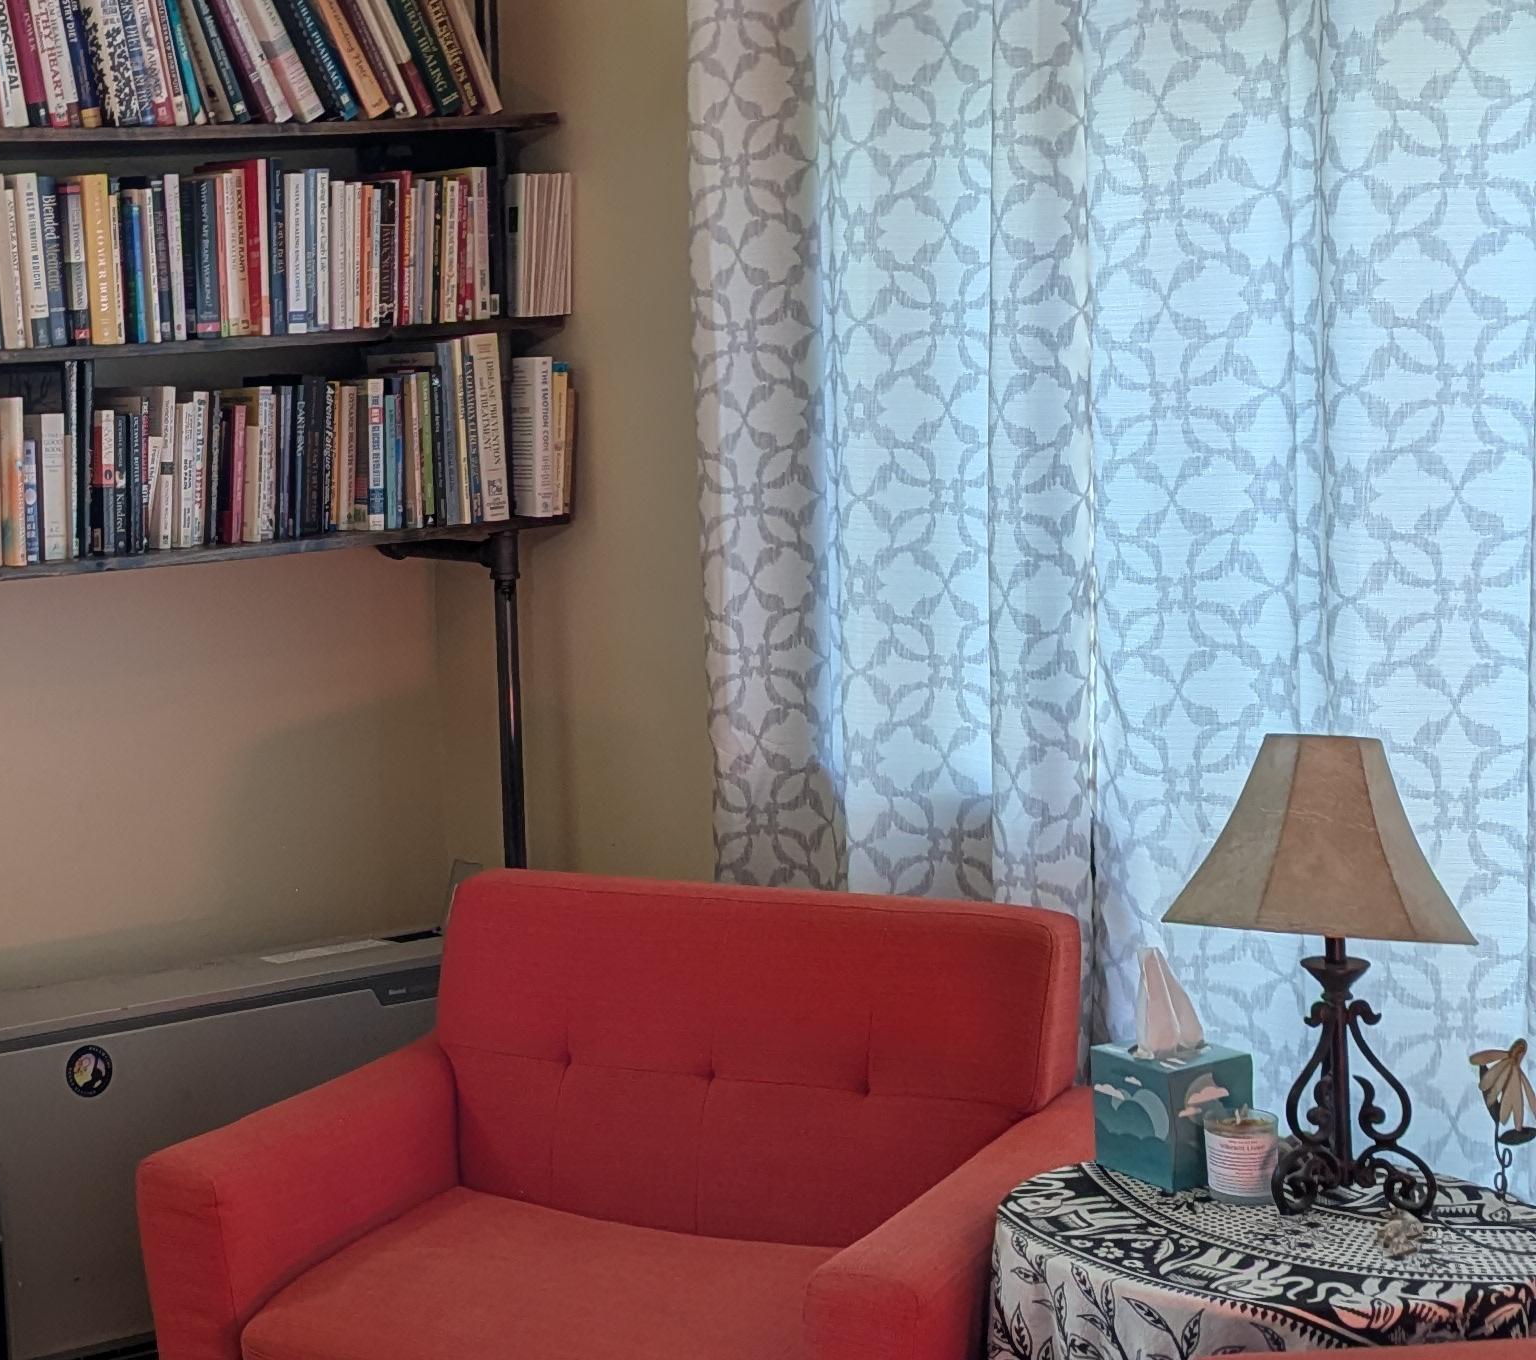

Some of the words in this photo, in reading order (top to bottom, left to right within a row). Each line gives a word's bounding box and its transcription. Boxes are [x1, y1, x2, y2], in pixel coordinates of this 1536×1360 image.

[47, 46, 63, 100] HEART
[318, 176, 326, 201] Living
[41, 194, 59, 240] Blended
[30, 254, 42, 290] MEDICINE
[45, 242, 62, 292] Medicine
[486, 360, 496, 400] DISEASE
[296, 400, 305, 456] EARTHING
[324, 385, 334, 429] Adrenal
[480, 393, 490, 451] TREATMENT
[322, 429, 332, 469] Fatigue
[489, 403, 500, 465] PREVENTION
[115, 493, 124, 532] Kindred
